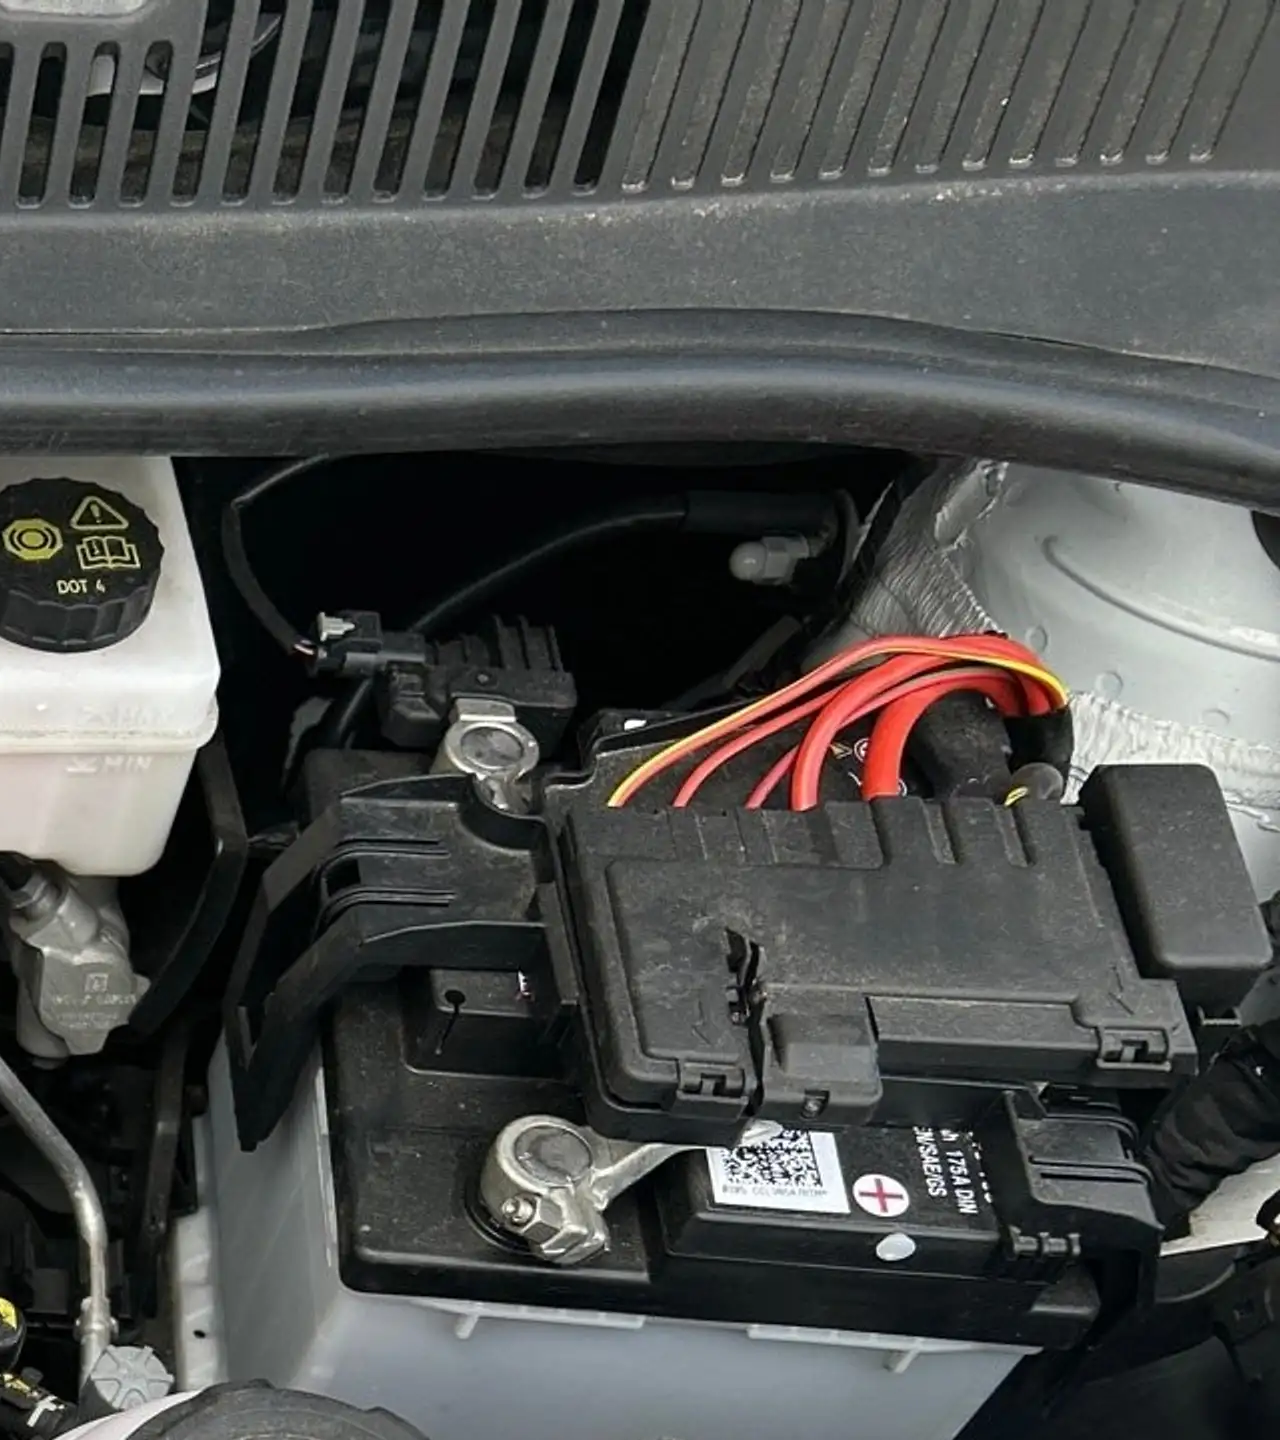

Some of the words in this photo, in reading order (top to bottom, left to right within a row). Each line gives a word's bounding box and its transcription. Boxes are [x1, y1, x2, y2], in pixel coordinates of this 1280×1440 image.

[56, 579, 88, 594] DOT
[95, 579, 106, 593] 4
[105, 755, 154, 772] MIN
[954, 1188, 979, 1214] DIN
